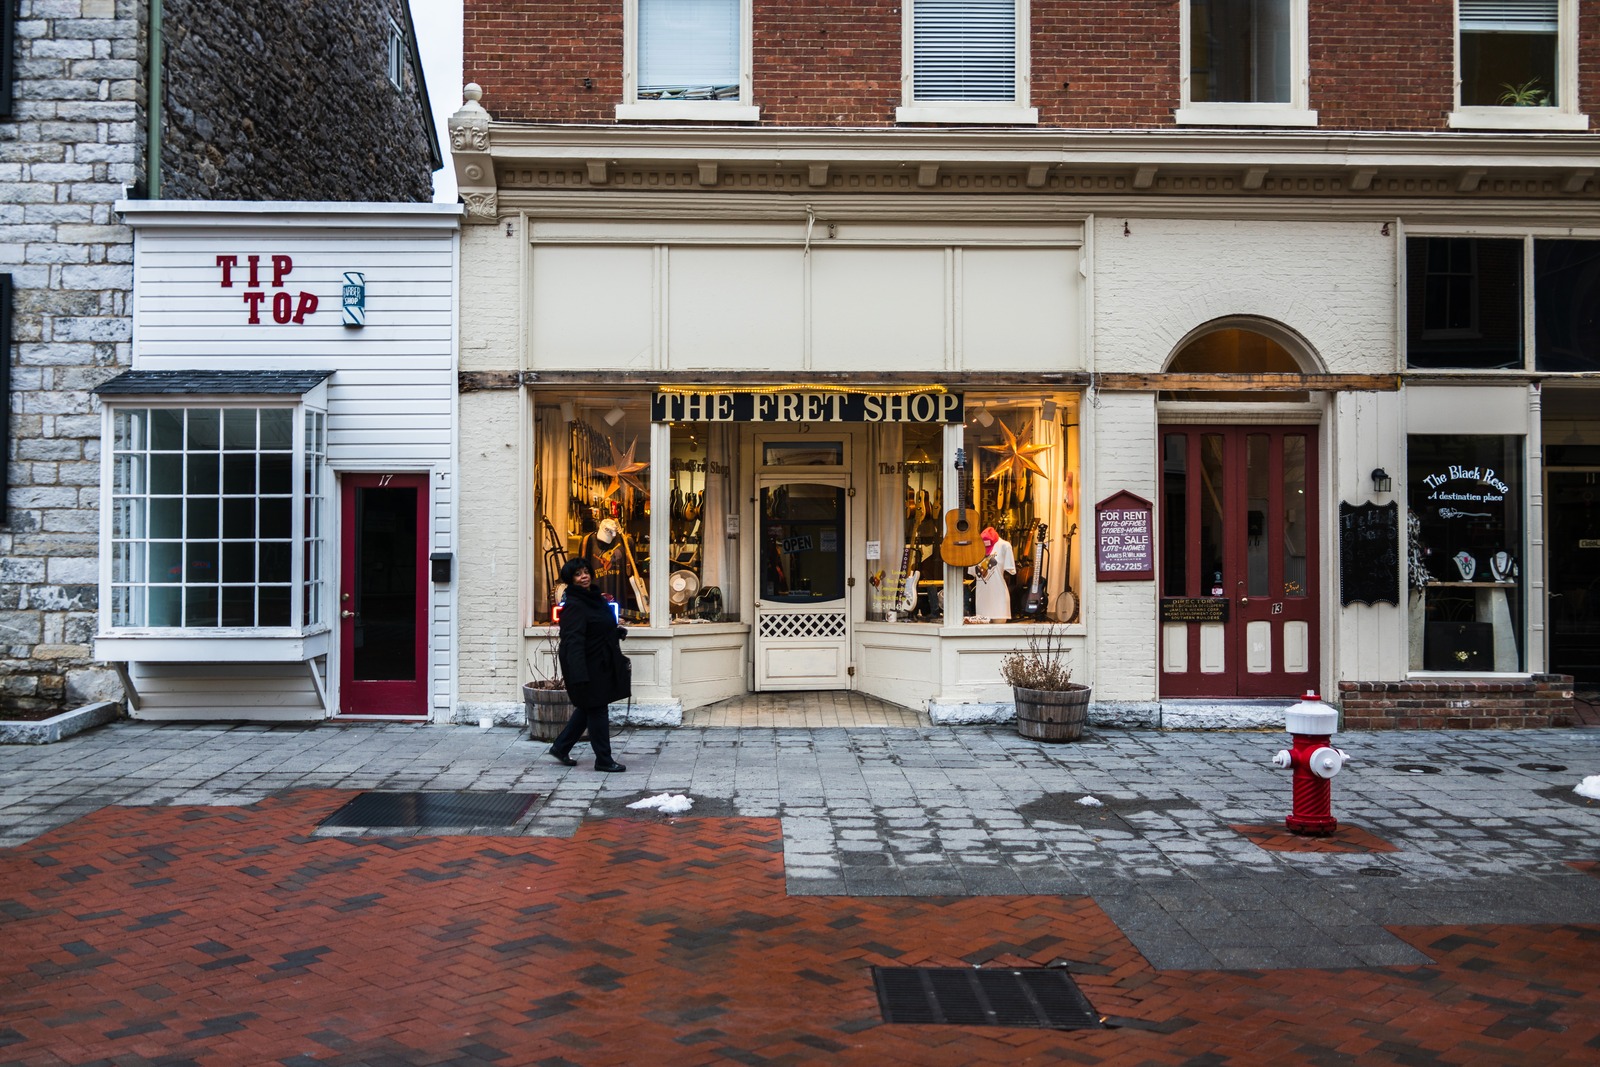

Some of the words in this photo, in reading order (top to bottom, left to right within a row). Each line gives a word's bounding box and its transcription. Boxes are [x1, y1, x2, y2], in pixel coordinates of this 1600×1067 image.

[216, 255, 293, 288] TIP
[344, 297, 359, 305] SHOP
[243, 291, 319, 325] TOP
[657, 392, 734, 422] THE
[750, 392, 848, 422] FRET
[863, 393, 959, 423] SHOP
[710, 461, 729, 478] Shop
[879, 462, 895, 475] The
[378, 474, 394, 487] 17
[1422, 473, 1448, 490] The
[1448, 465, 1480, 480] Black
[1482, 468, 1509, 494] Rose
[1427, 491, 1438, 500] A
[1439, 491, 1482, 501] destination
[1483, 492, 1503, 503] place
[1100, 511, 1119, 521] FOR
[1123, 511, 1147, 520] RENT
[783, 535, 812, 552] OPEN
[1101, 536, 1120, 545] FOR
[1124, 535, 1148, 544] SALE
[1272, 603, 1283, 614] 13
